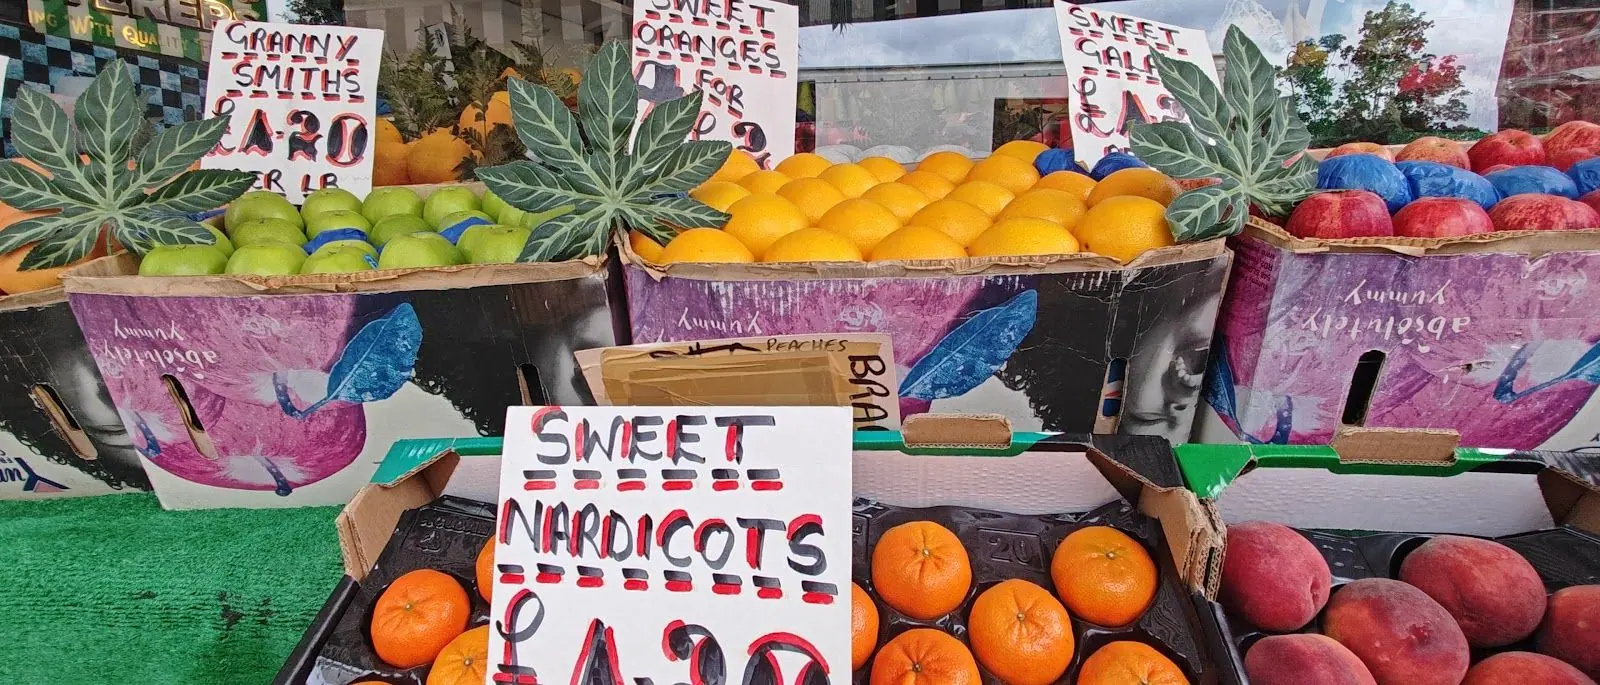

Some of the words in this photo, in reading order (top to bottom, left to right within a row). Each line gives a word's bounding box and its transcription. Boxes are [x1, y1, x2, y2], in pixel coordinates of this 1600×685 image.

[122, 25, 187, 49] QUAITY
[224, 22, 358, 61] GRANNY
[1068, 5, 1180, 46] SWEET
[634, 22, 782, 69] ORANGES
[233, 59, 362, 94] SMITHS
[695, 68, 746, 110] FOR
[301, 172, 340, 193] LB
[1344, 278, 1452, 306] yummy
[114, 317, 184, 341] yummy
[678, 306, 763, 335] yummy
[1302, 307, 1471, 342] absolutely
[103, 338, 218, 370] absolutely
[766, 338, 849, 353] PEACHES
[847, 354, 891, 432] BRA
[531, 405, 776, 466] SWEET
[498, 496, 828, 576] NARDICOTS
